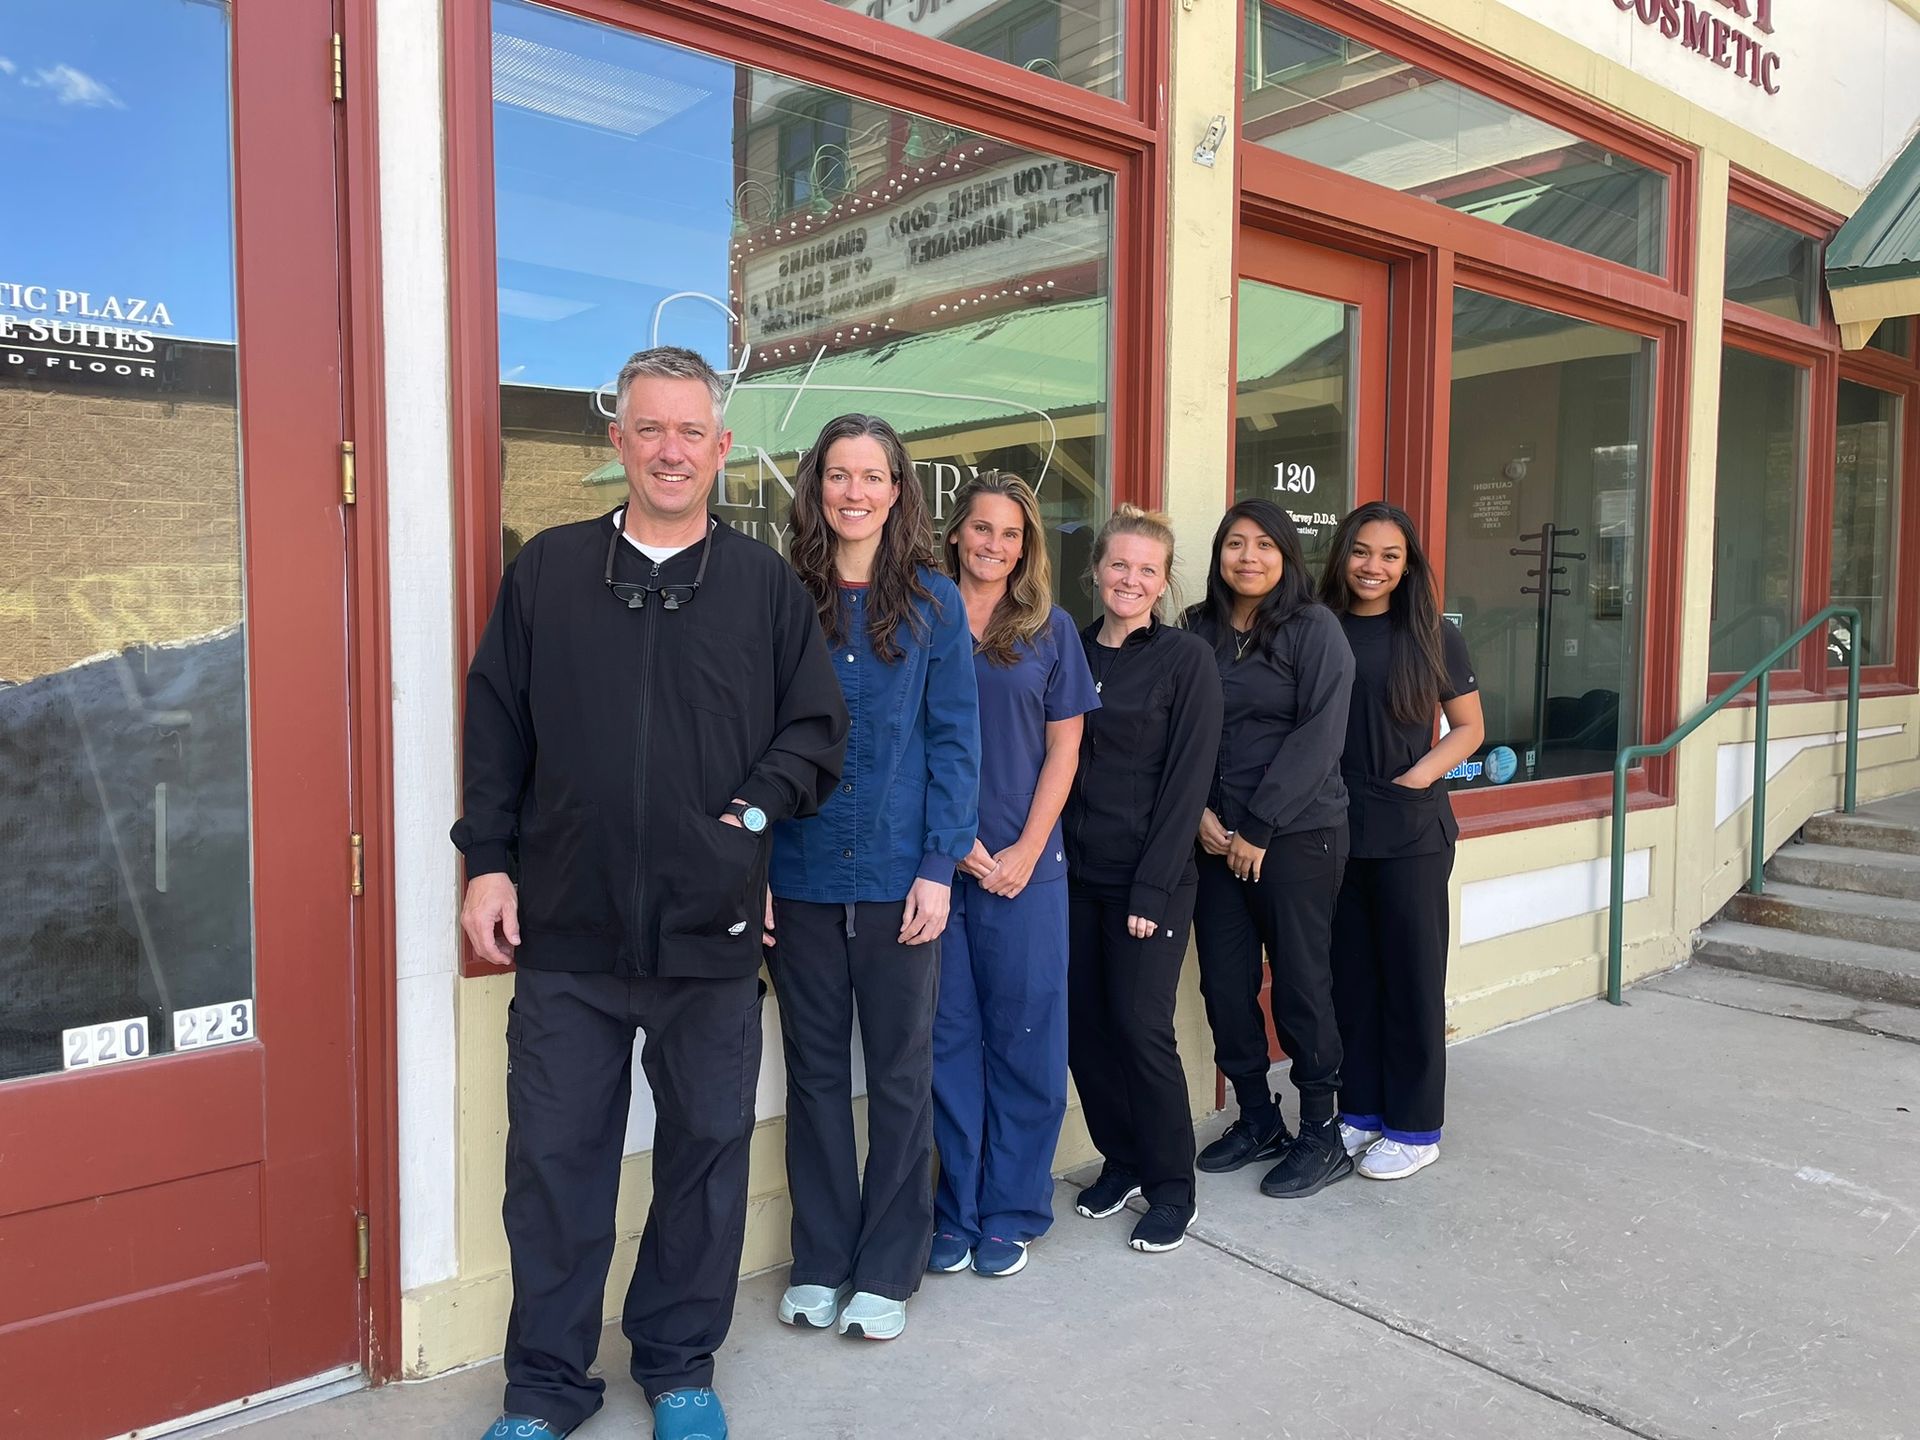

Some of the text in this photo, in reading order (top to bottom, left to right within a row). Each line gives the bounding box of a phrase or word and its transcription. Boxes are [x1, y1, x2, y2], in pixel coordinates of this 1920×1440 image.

[1613, 0, 1780, 95] OSMETIC
[57, 289, 173, 326] PLAZA
[29, 317, 154, 353] SUITES
[46, 357, 156, 378] FLOOR
[1273, 462, 1316, 494] 120
[1313, 512, 1338, 526] D.D.S.
[68, 1004, 249, 1066] 220 223
